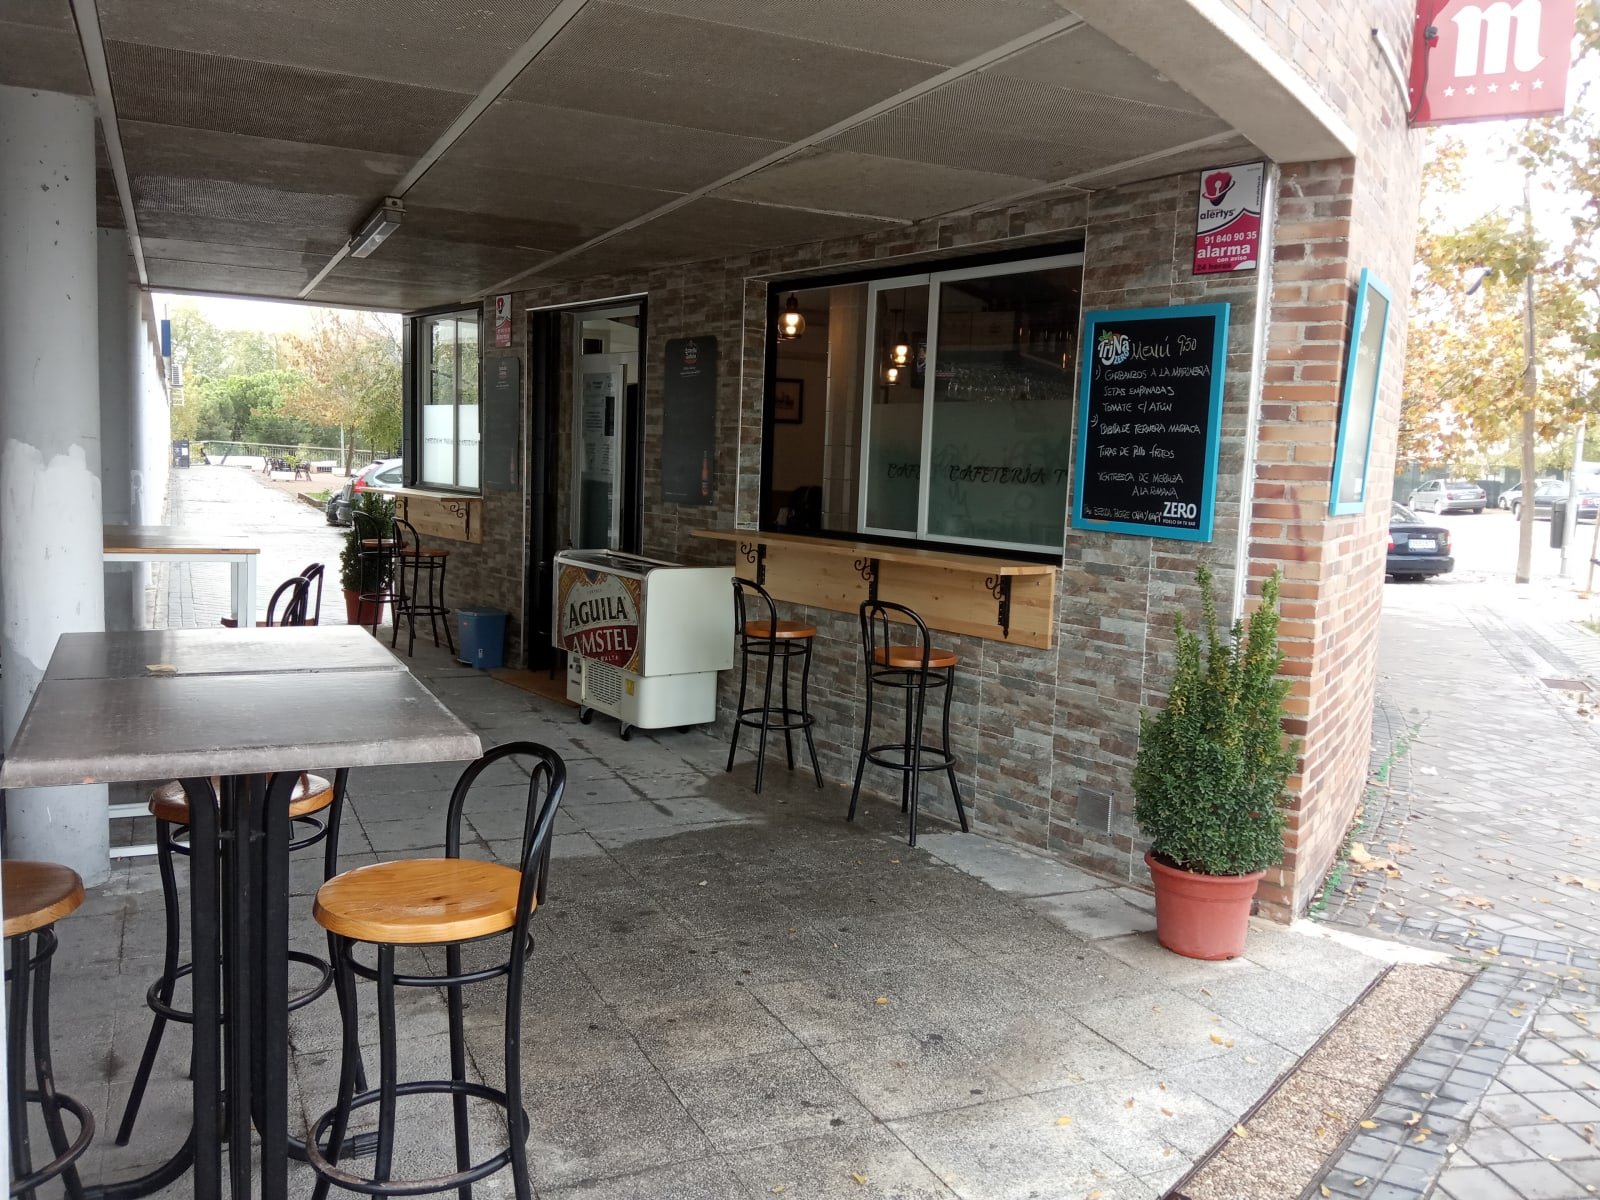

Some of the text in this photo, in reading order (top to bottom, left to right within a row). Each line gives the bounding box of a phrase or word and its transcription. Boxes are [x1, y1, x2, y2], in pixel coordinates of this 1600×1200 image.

[1200, 209, 1234, 220] alertys
[1204, 231, 1257, 244] 91 840 90 35
[1197, 244, 1251, 259] alarma
[1113, 350, 1130, 365] ZERO
[1151, 368, 1158, 378] A
[1159, 367, 1171, 377] LA
[1104, 386, 1127, 397] SETAS
[1102, 402, 1132, 412] TOMATE
[1119, 446, 1130, 457] DE
[1139, 472, 1150, 483] DE
[1132, 485, 1140, 497] A
[1140, 486, 1149, 496] LA
[1163, 501, 1197, 519] ZERO
[573, 628, 633, 656] AMSTEL
